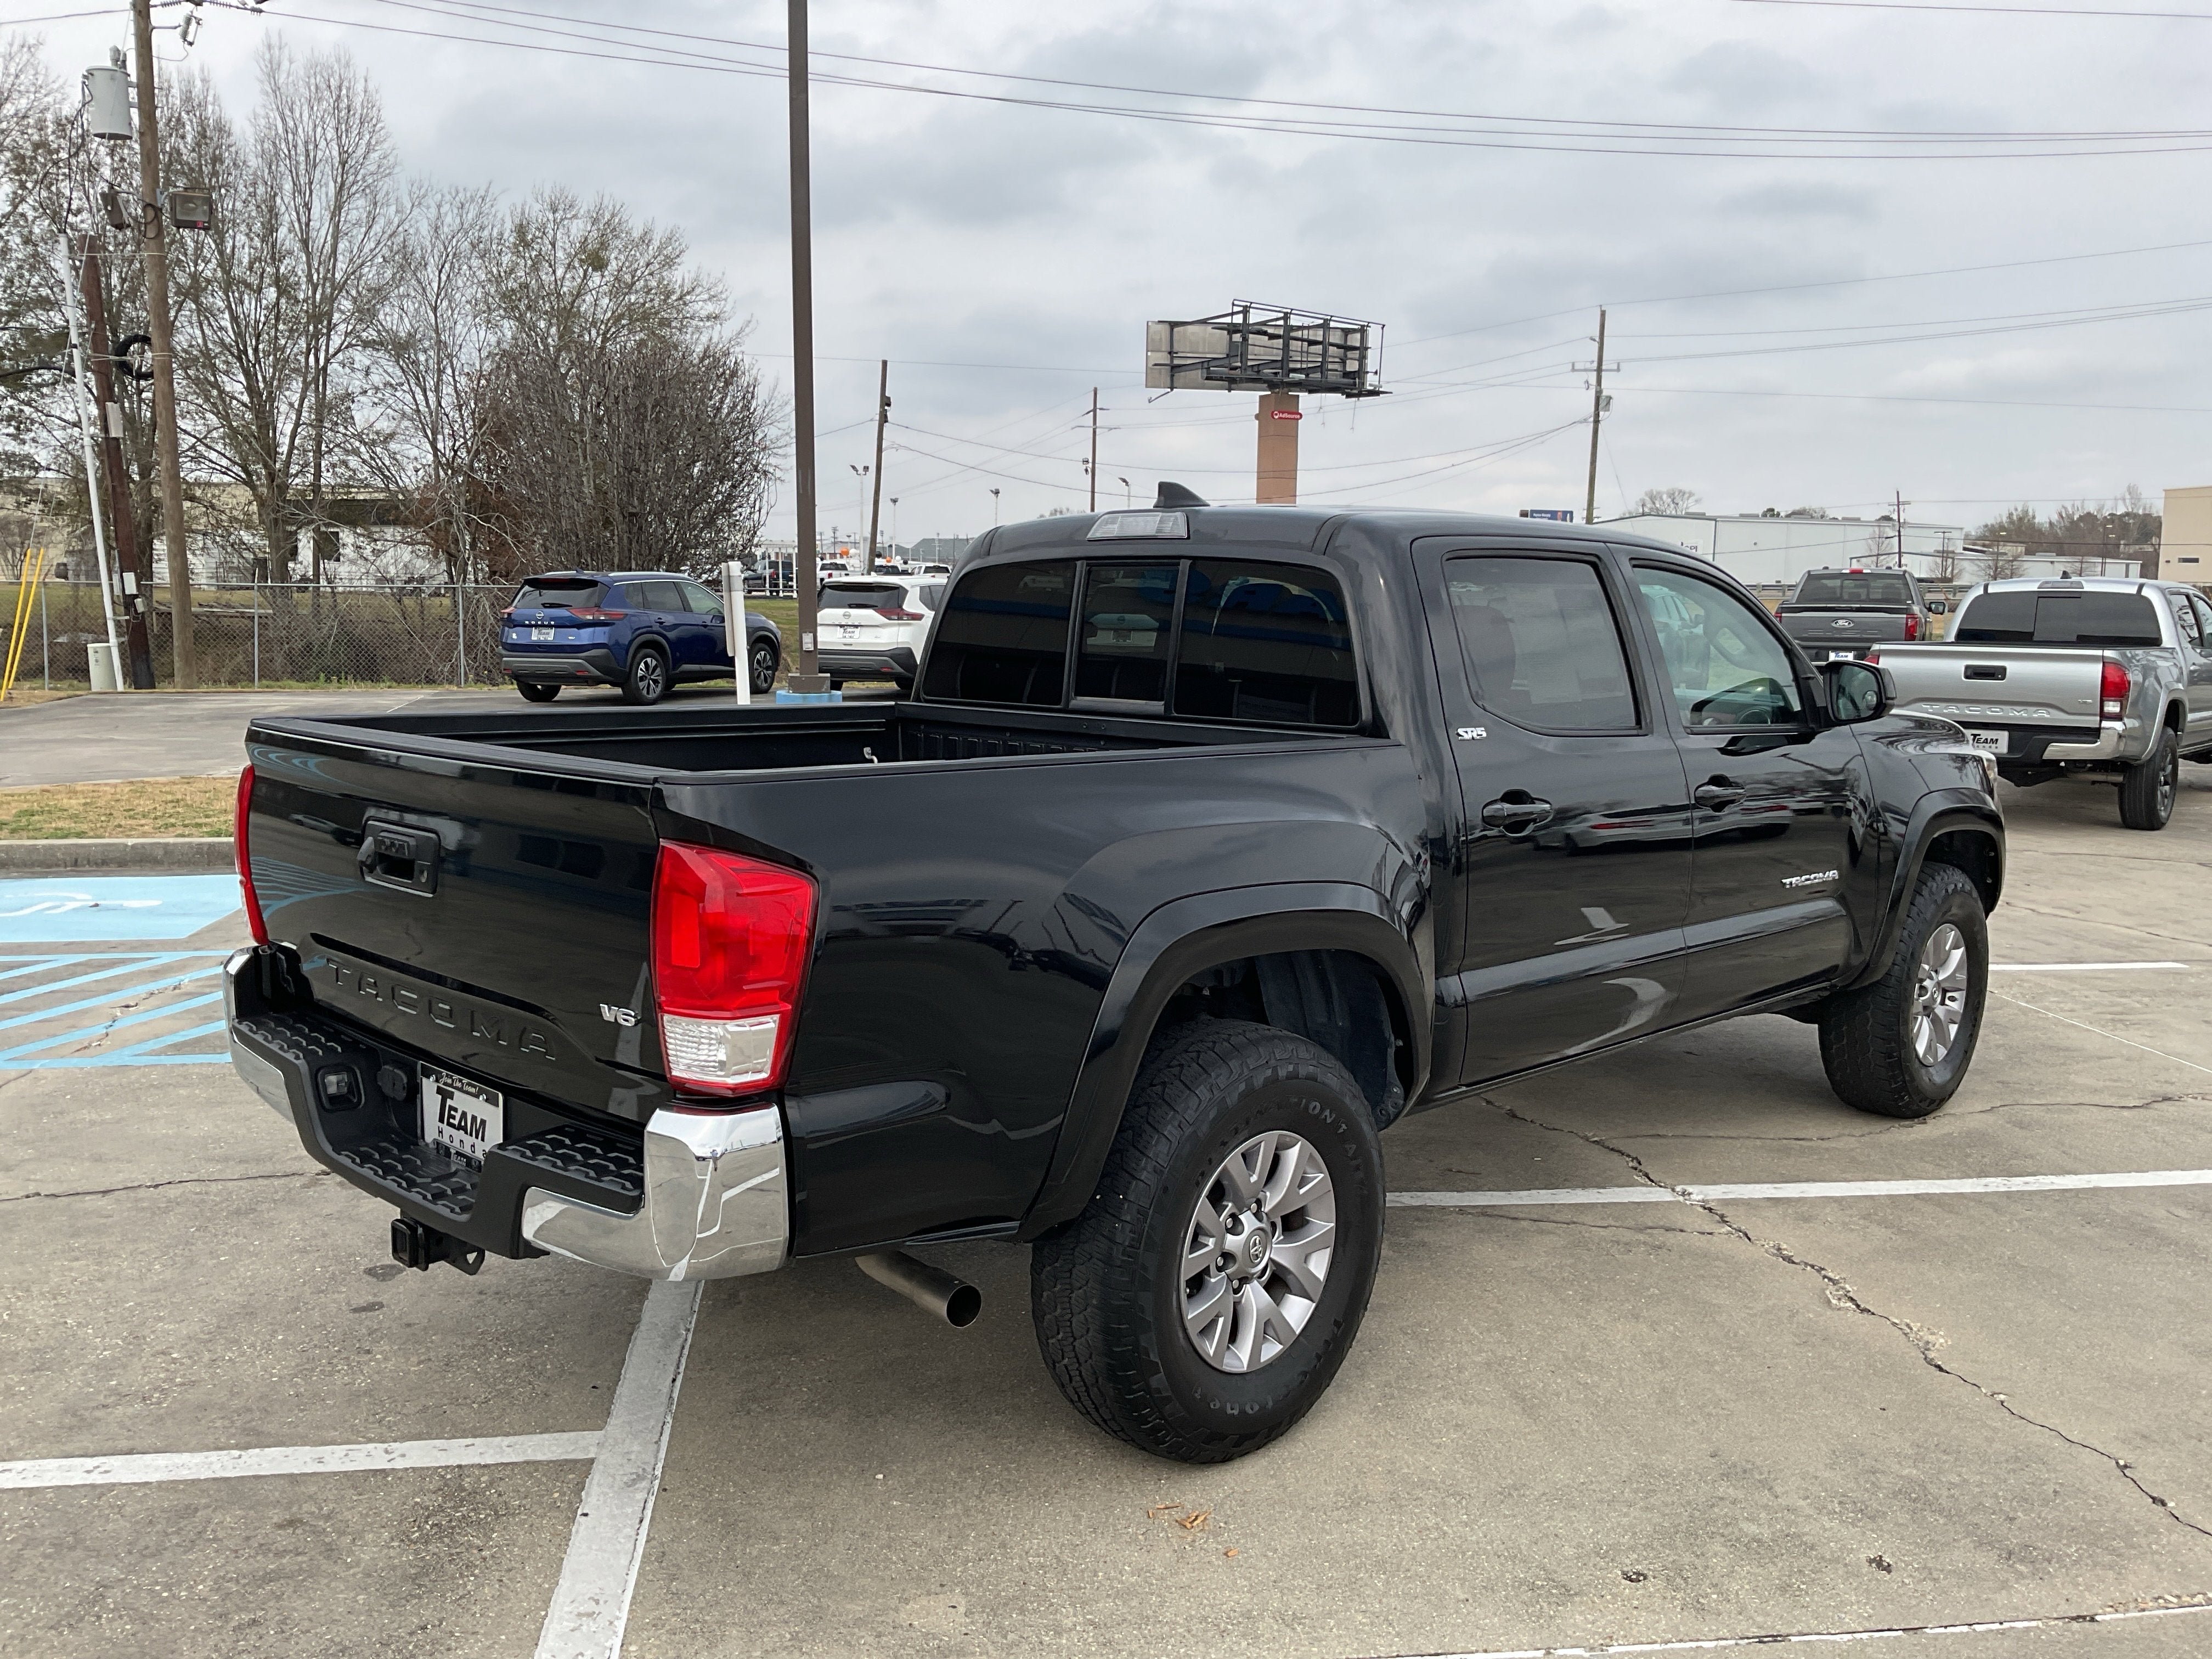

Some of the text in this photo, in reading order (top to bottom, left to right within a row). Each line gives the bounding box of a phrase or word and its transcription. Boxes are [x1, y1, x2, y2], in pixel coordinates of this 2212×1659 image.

[1922, 703, 2051, 717] TACOMA
[1457, 727, 1487, 740] SR5
[1970, 733, 1999, 745] TEAM
[1781, 870, 1839, 889] TACOMA
[326, 958, 556, 1060] TACOMA
[599, 1003, 636, 1027] V6
[439, 1072, 452, 1084] Join
[453, 1076, 462, 1088] The
[436, 1085, 487, 1143] TEAM
[437, 1126, 487, 1159] Honda
